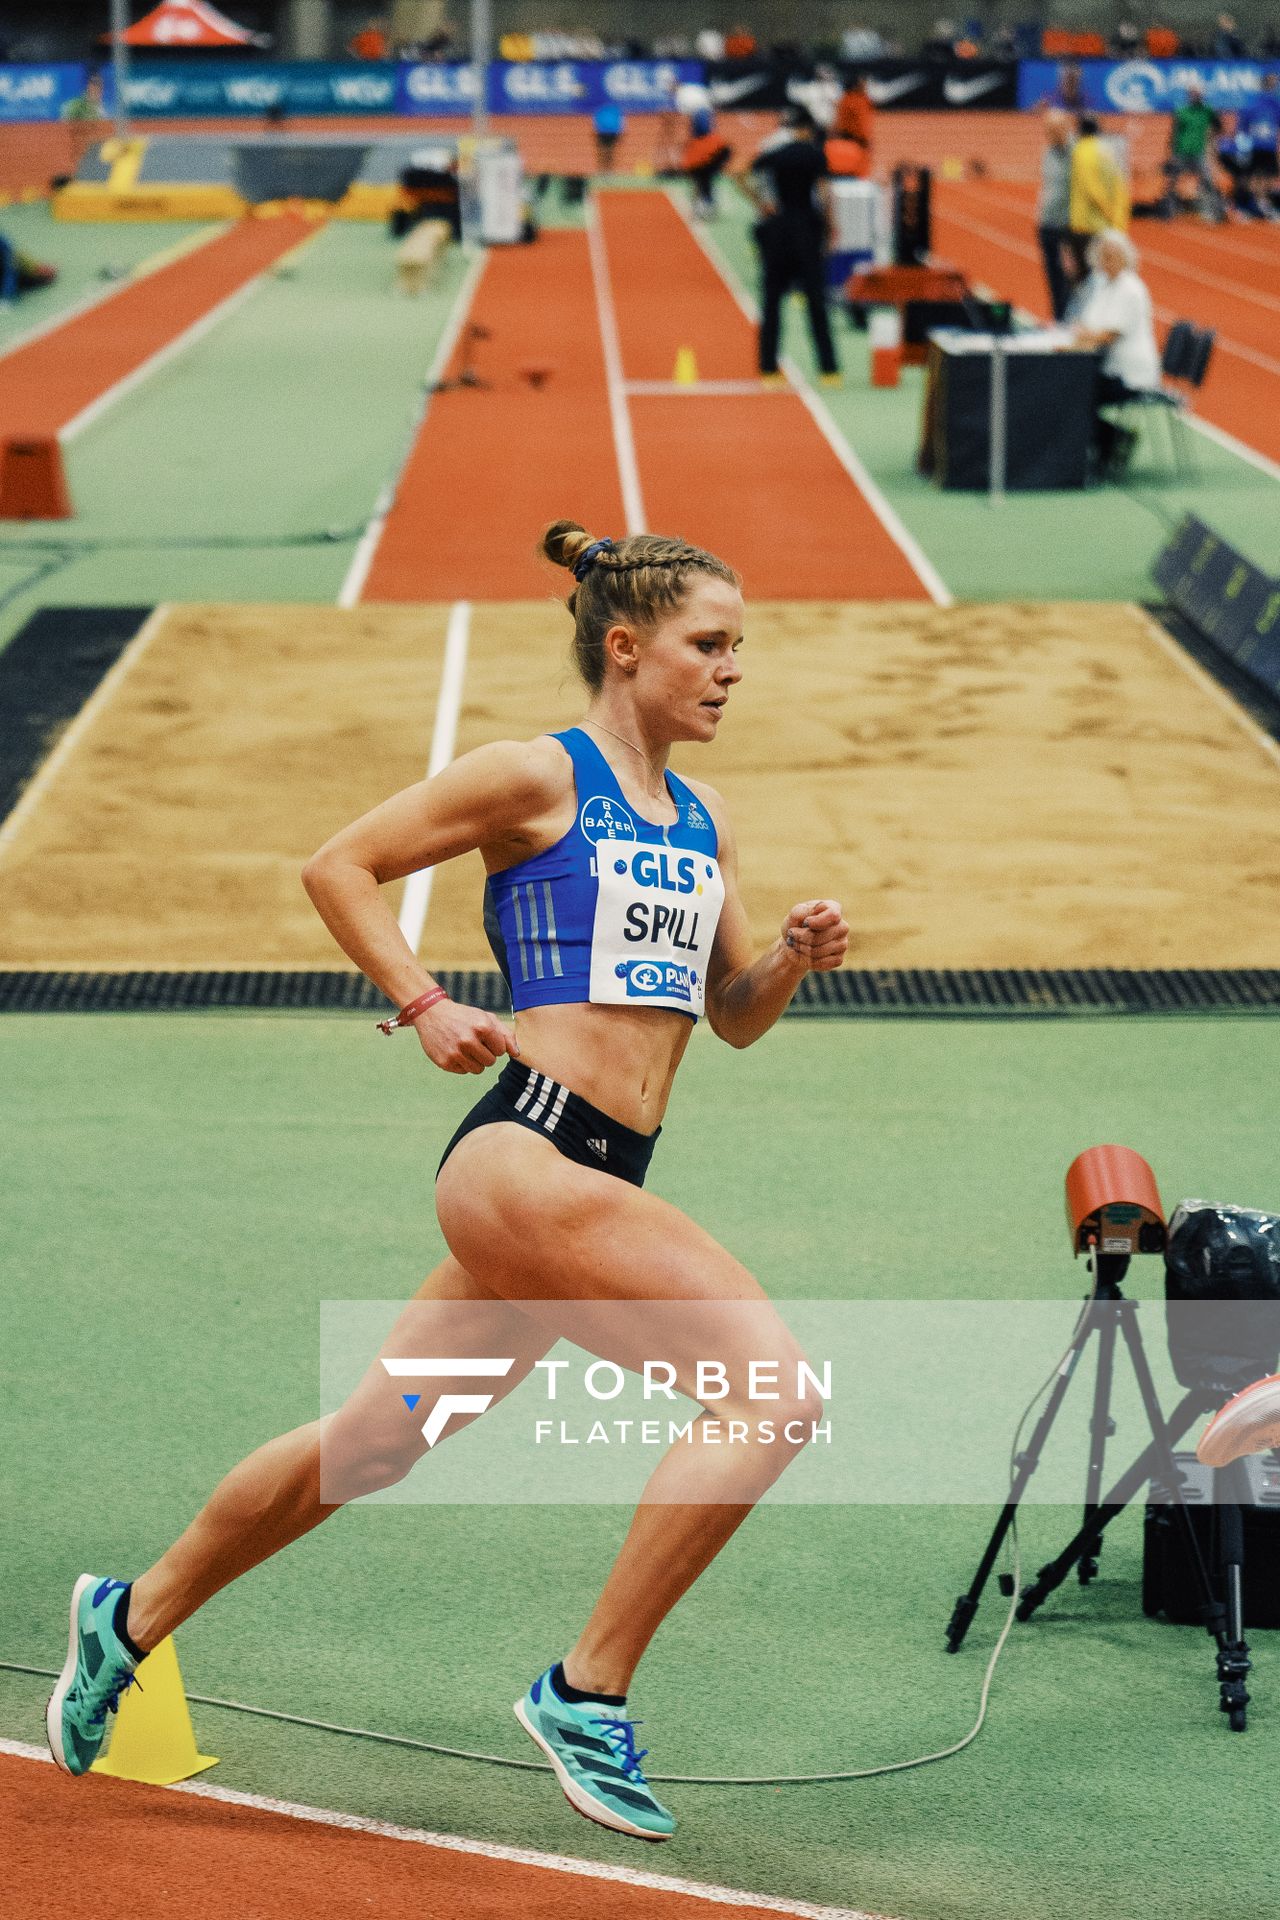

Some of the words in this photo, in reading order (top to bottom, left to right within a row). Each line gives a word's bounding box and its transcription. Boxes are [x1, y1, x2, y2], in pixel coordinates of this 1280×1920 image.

[585, 817, 632, 833] BAYER
[602, 800, 616, 840] BAYE
[623, 902, 699, 951] SPILL
